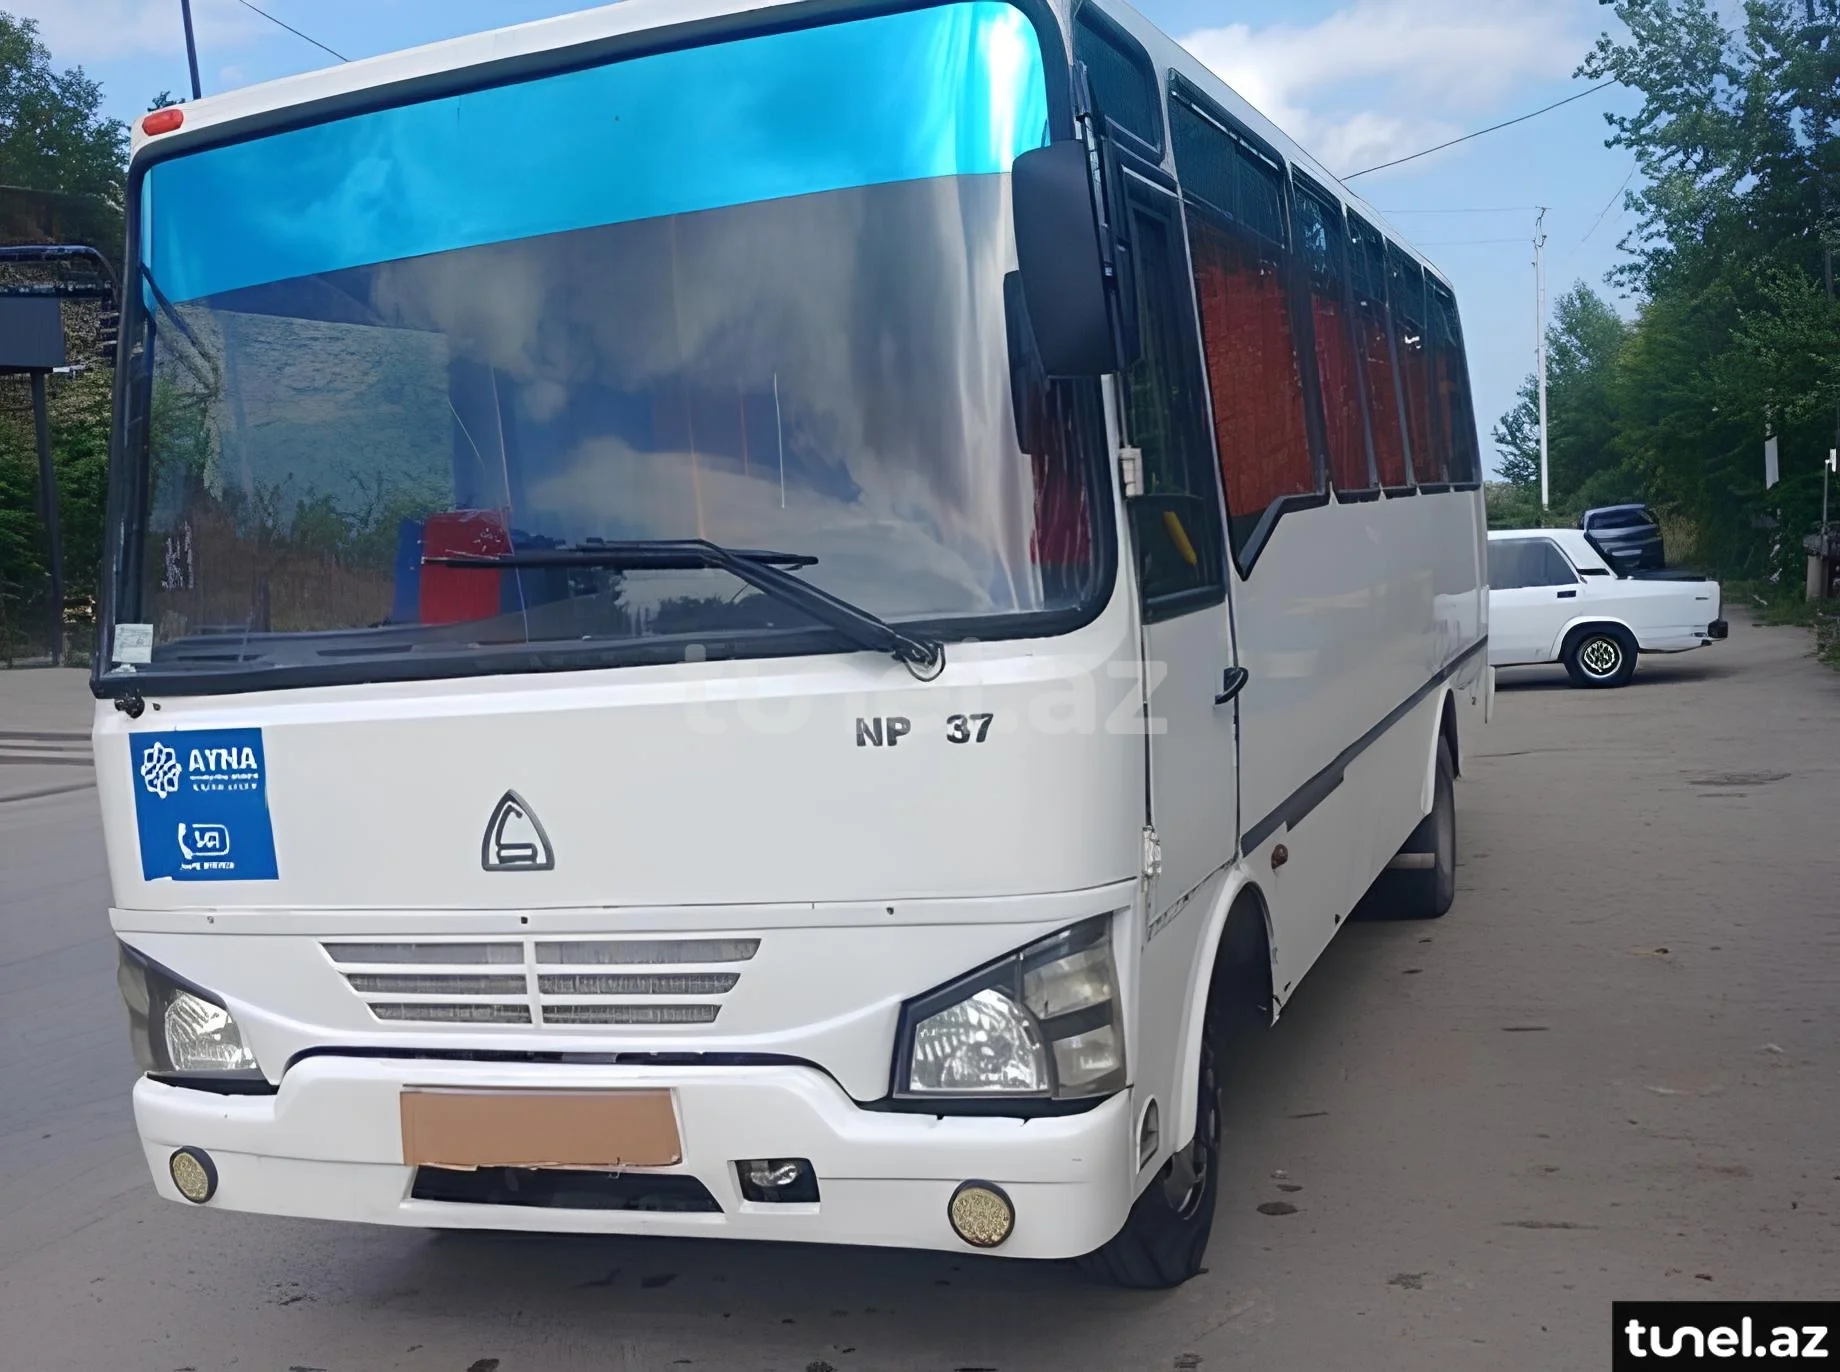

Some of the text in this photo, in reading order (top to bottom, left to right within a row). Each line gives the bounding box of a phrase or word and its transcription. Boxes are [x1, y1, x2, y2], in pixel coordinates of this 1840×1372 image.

[856, 713, 994, 747] NP 37
[189, 747, 258, 772] AYNA
